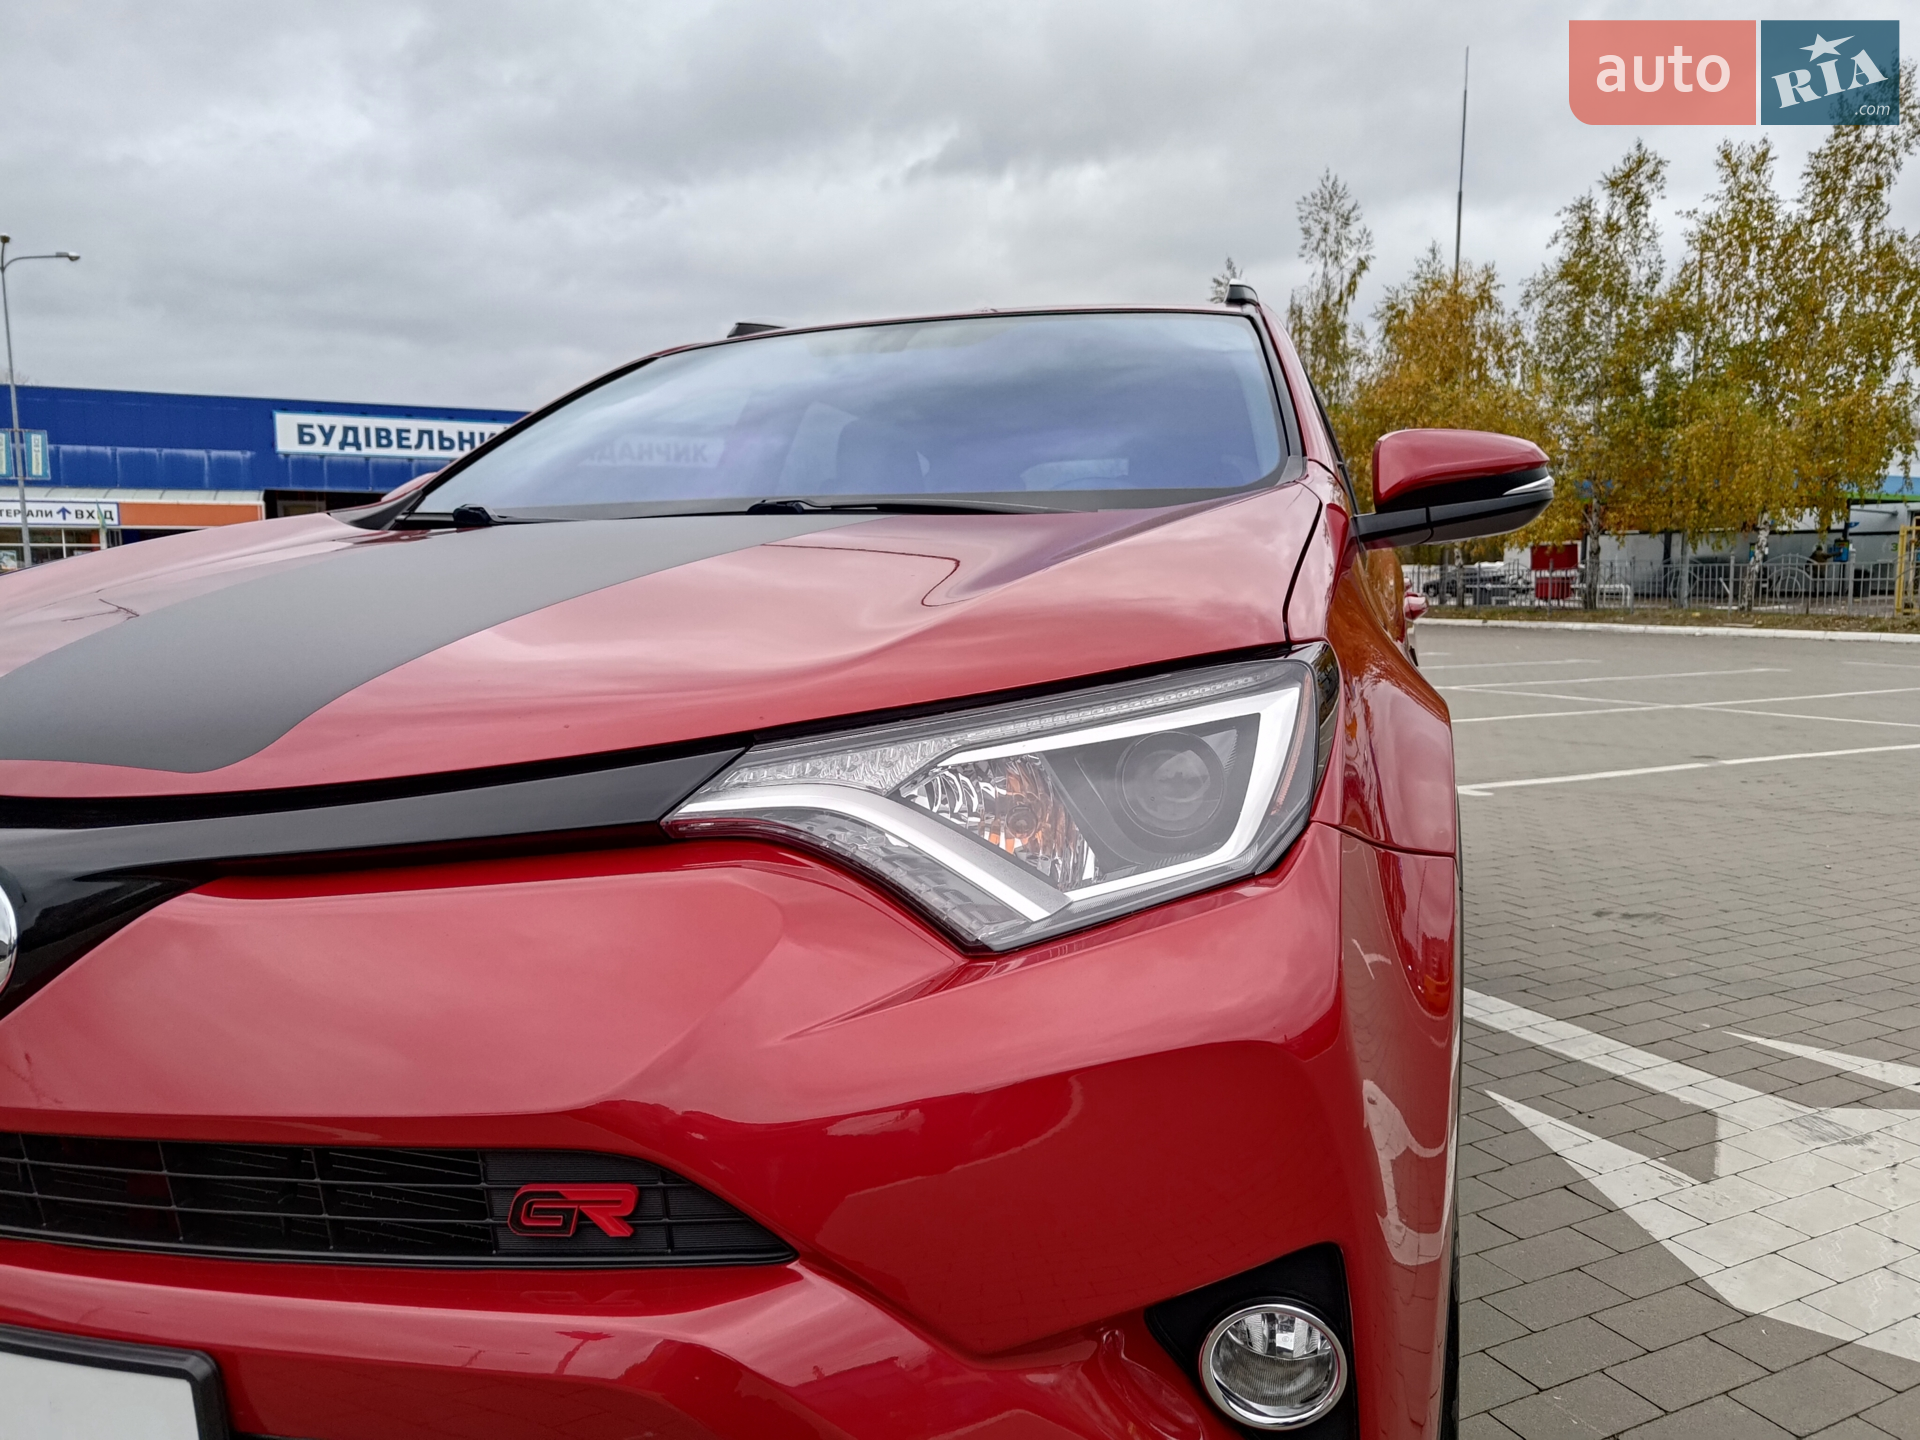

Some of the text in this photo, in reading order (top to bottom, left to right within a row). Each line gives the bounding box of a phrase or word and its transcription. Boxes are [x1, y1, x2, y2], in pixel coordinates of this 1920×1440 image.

[297, 423, 708, 463] БУДІВЕЛЬН ДАНЧИК
[0, 508, 114, 521] ТЕРАЛИ ВХД
[507, 1183, 640, 1237] GR
